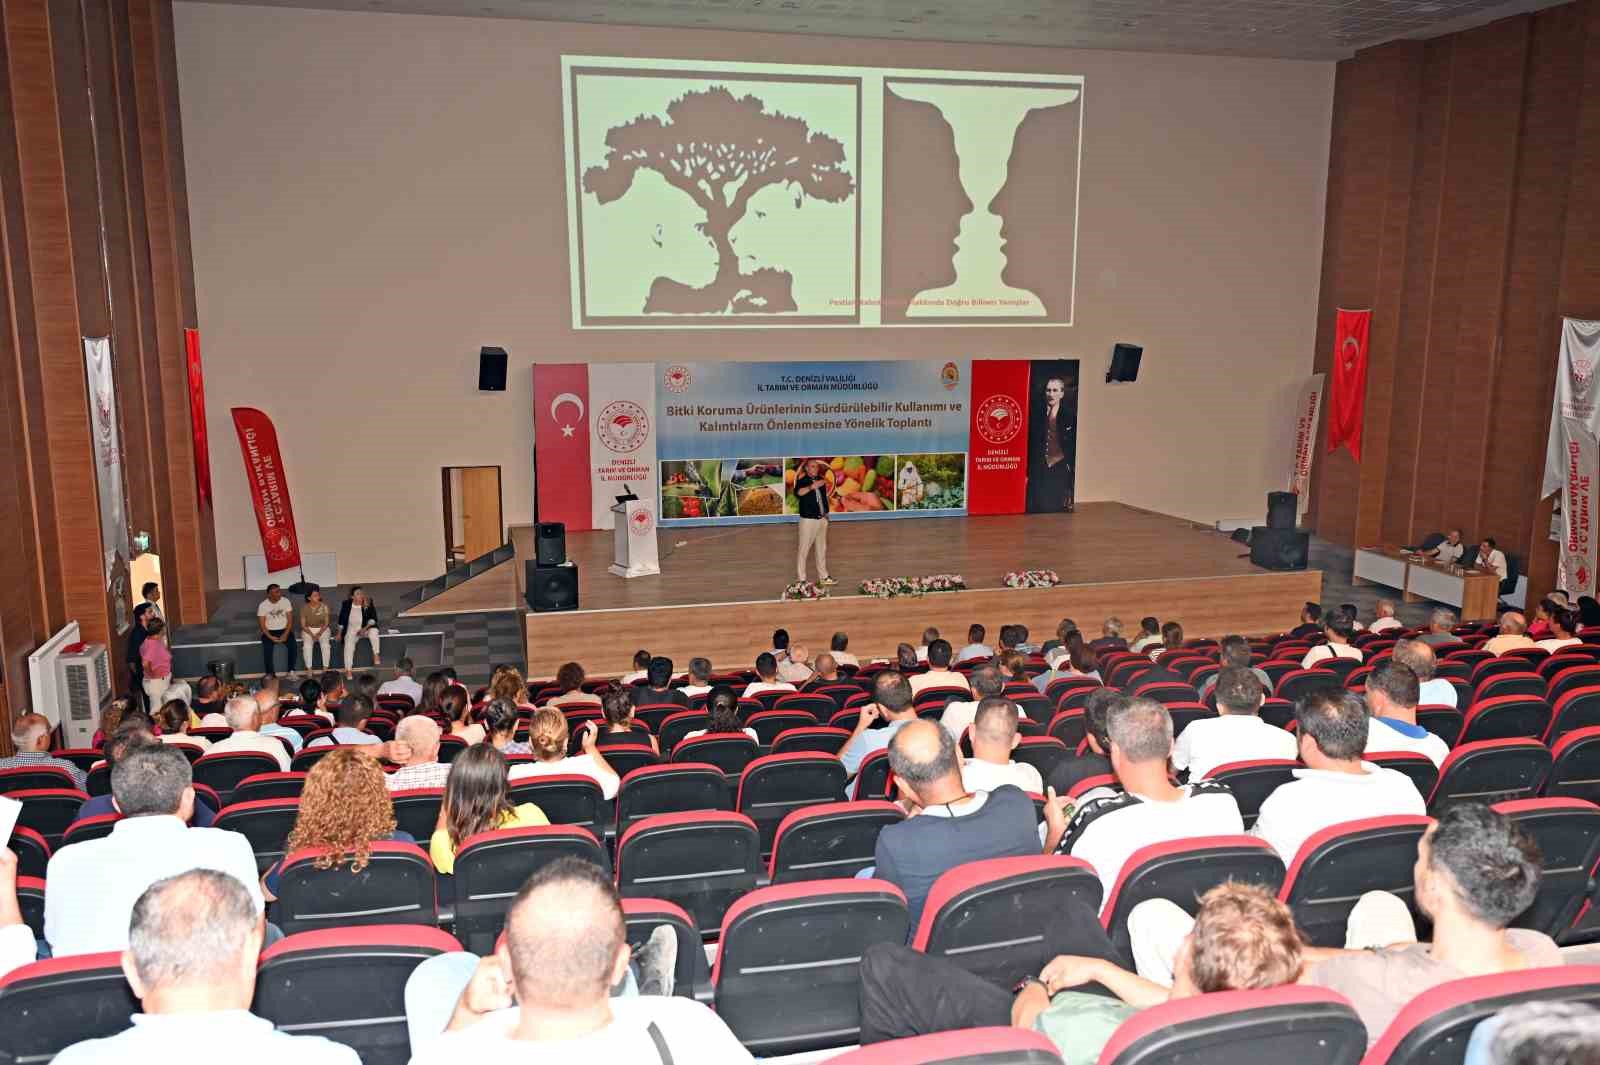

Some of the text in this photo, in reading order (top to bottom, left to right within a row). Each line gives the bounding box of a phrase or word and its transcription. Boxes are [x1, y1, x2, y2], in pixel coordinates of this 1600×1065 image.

[796, 373, 824, 383] DENİZLİ
[766, 383, 788, 392] TARIM
[790, 383, 800, 391] VE
[801, 382, 829, 391] ORMAN
[667, 401, 962, 416] Bitki Koruma Ürünlerinin Sürdürülebilir Kullanımı ve
[699, 417, 932, 432] Kalıntıların Önlenmesine Yönelik Toplantı
